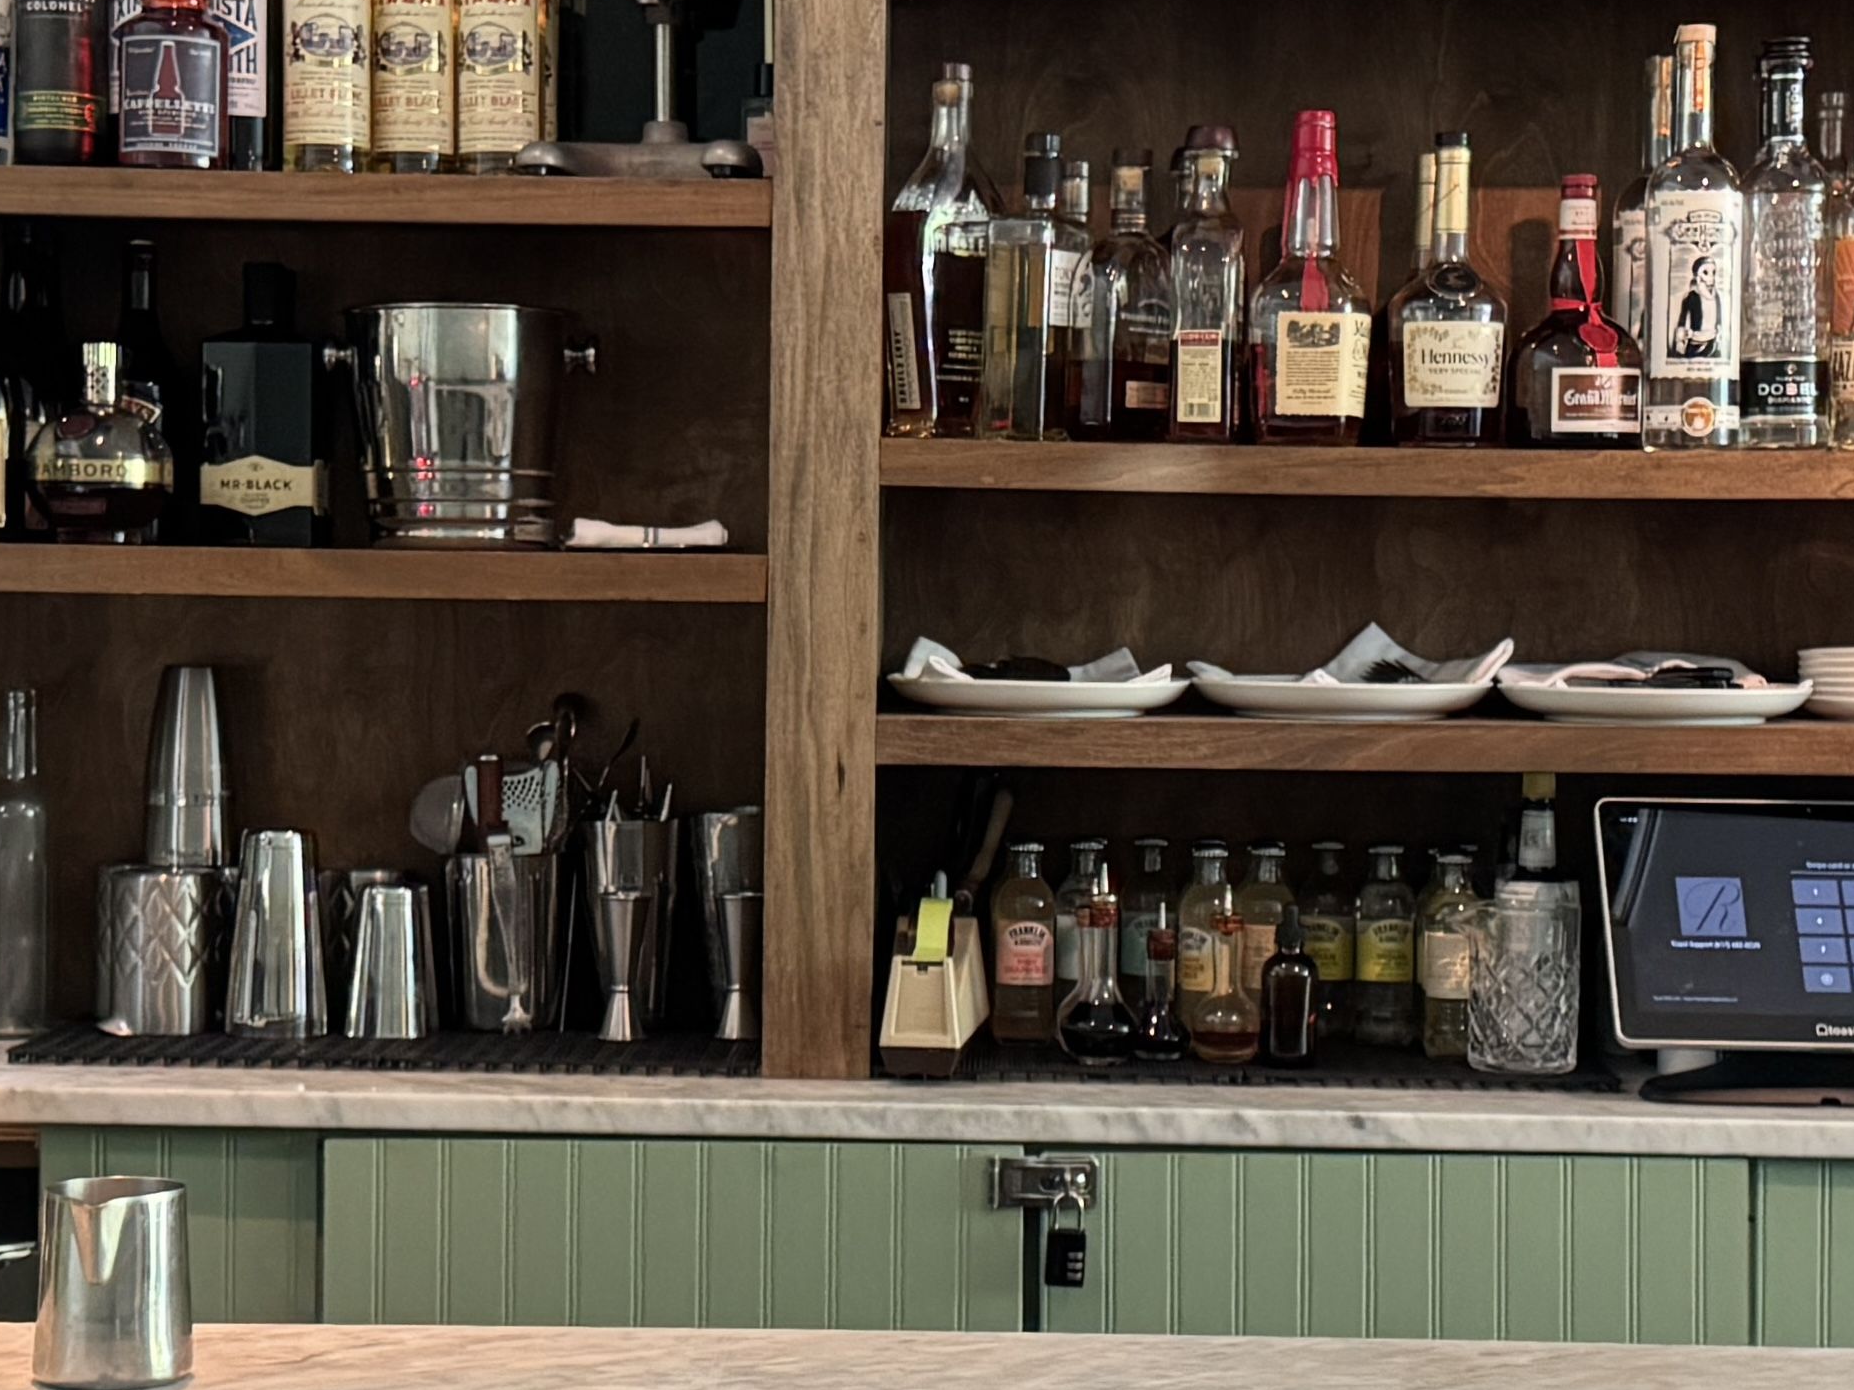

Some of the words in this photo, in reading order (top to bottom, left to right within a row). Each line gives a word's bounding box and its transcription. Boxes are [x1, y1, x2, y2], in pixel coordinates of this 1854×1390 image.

[26, 2, 82, 13] COLONEL
[1421, 349, 1489, 368] Hennessy
[1758, 383, 1818, 396] DOBEL
[246, 478, 294, 491] BLACK
